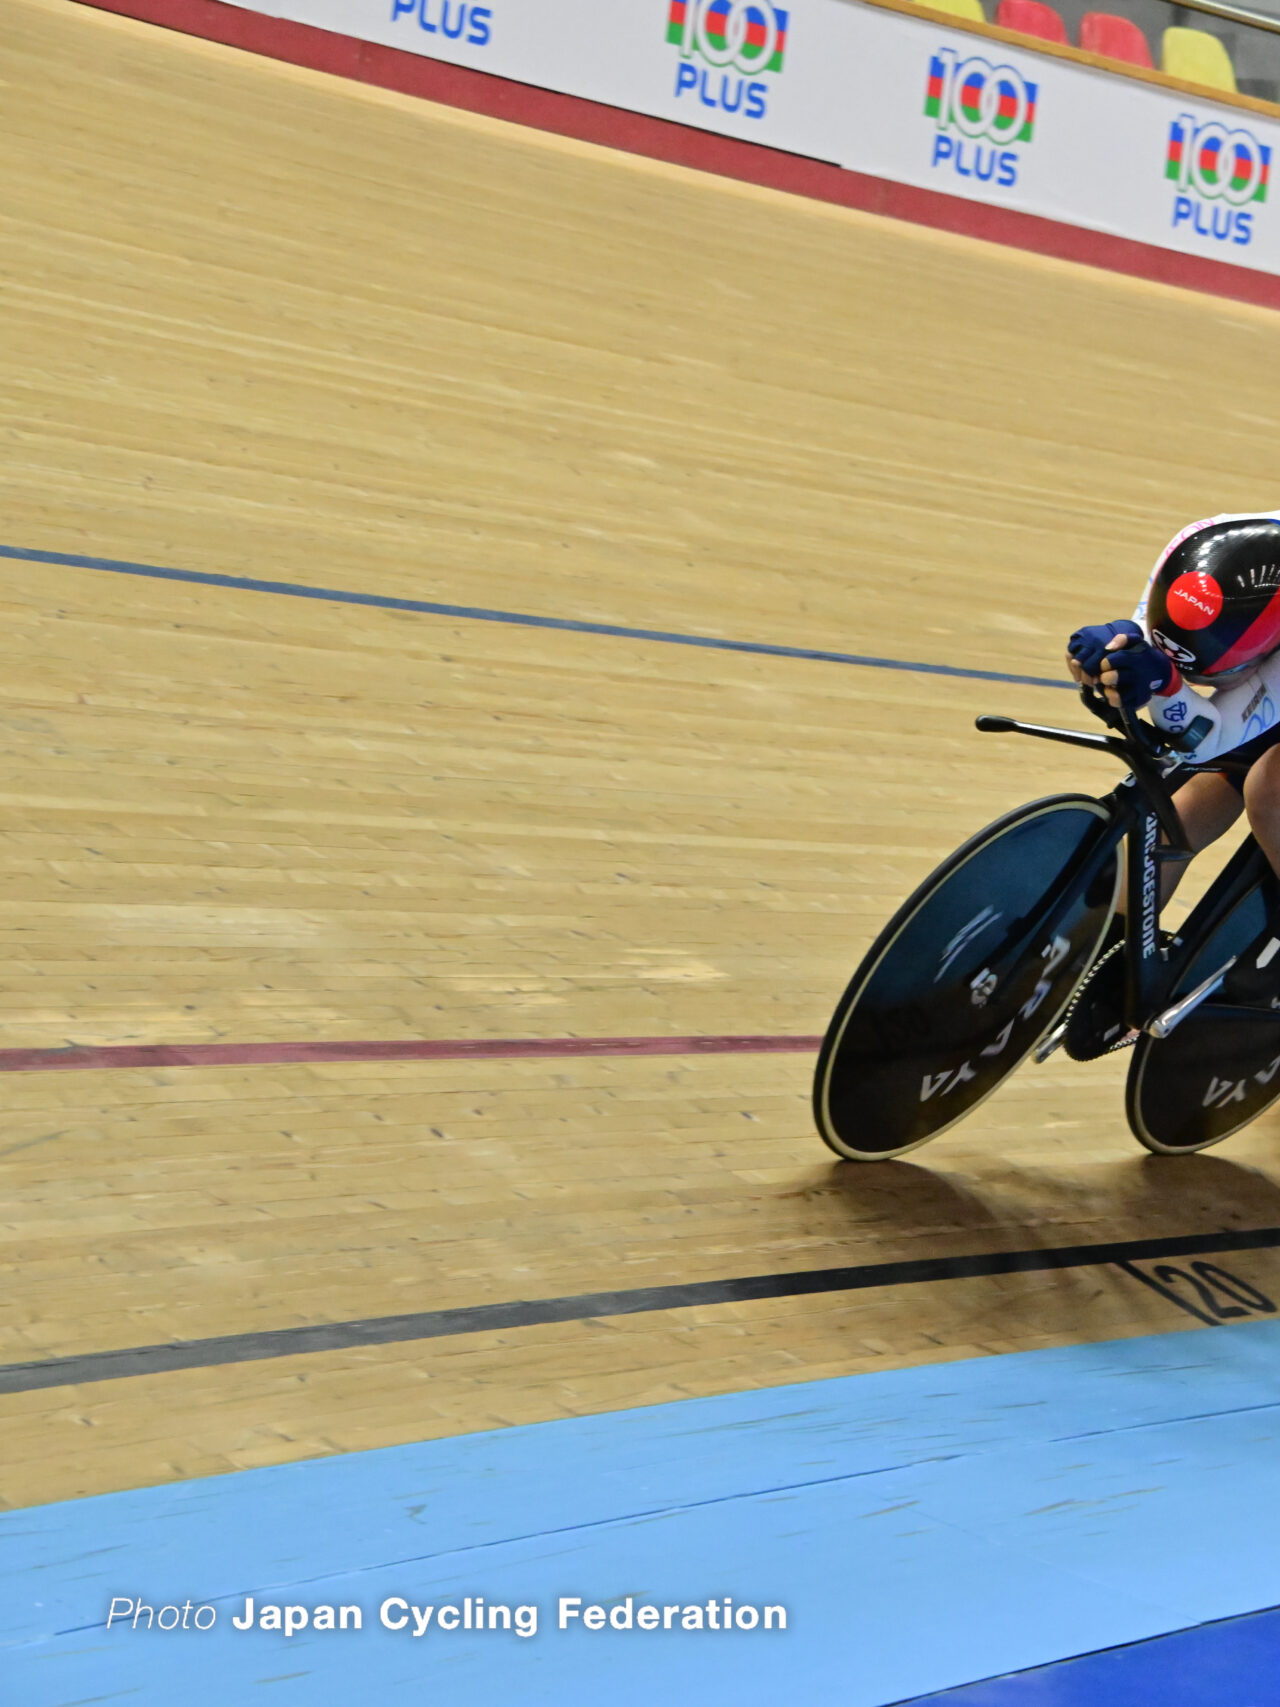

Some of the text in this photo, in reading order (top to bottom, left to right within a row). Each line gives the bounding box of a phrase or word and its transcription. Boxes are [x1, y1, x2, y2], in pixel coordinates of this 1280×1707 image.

[391, 0, 491, 46] PLUS
[674, 62, 767, 119] PLUS
[924, 47, 1038, 146] 100
[932, 134, 1018, 186] PLUS
[1165, 112, 1271, 207] 100
[1172, 196, 1253, 245] PLUS
[1173, 588, 1215, 616] JAPAN
